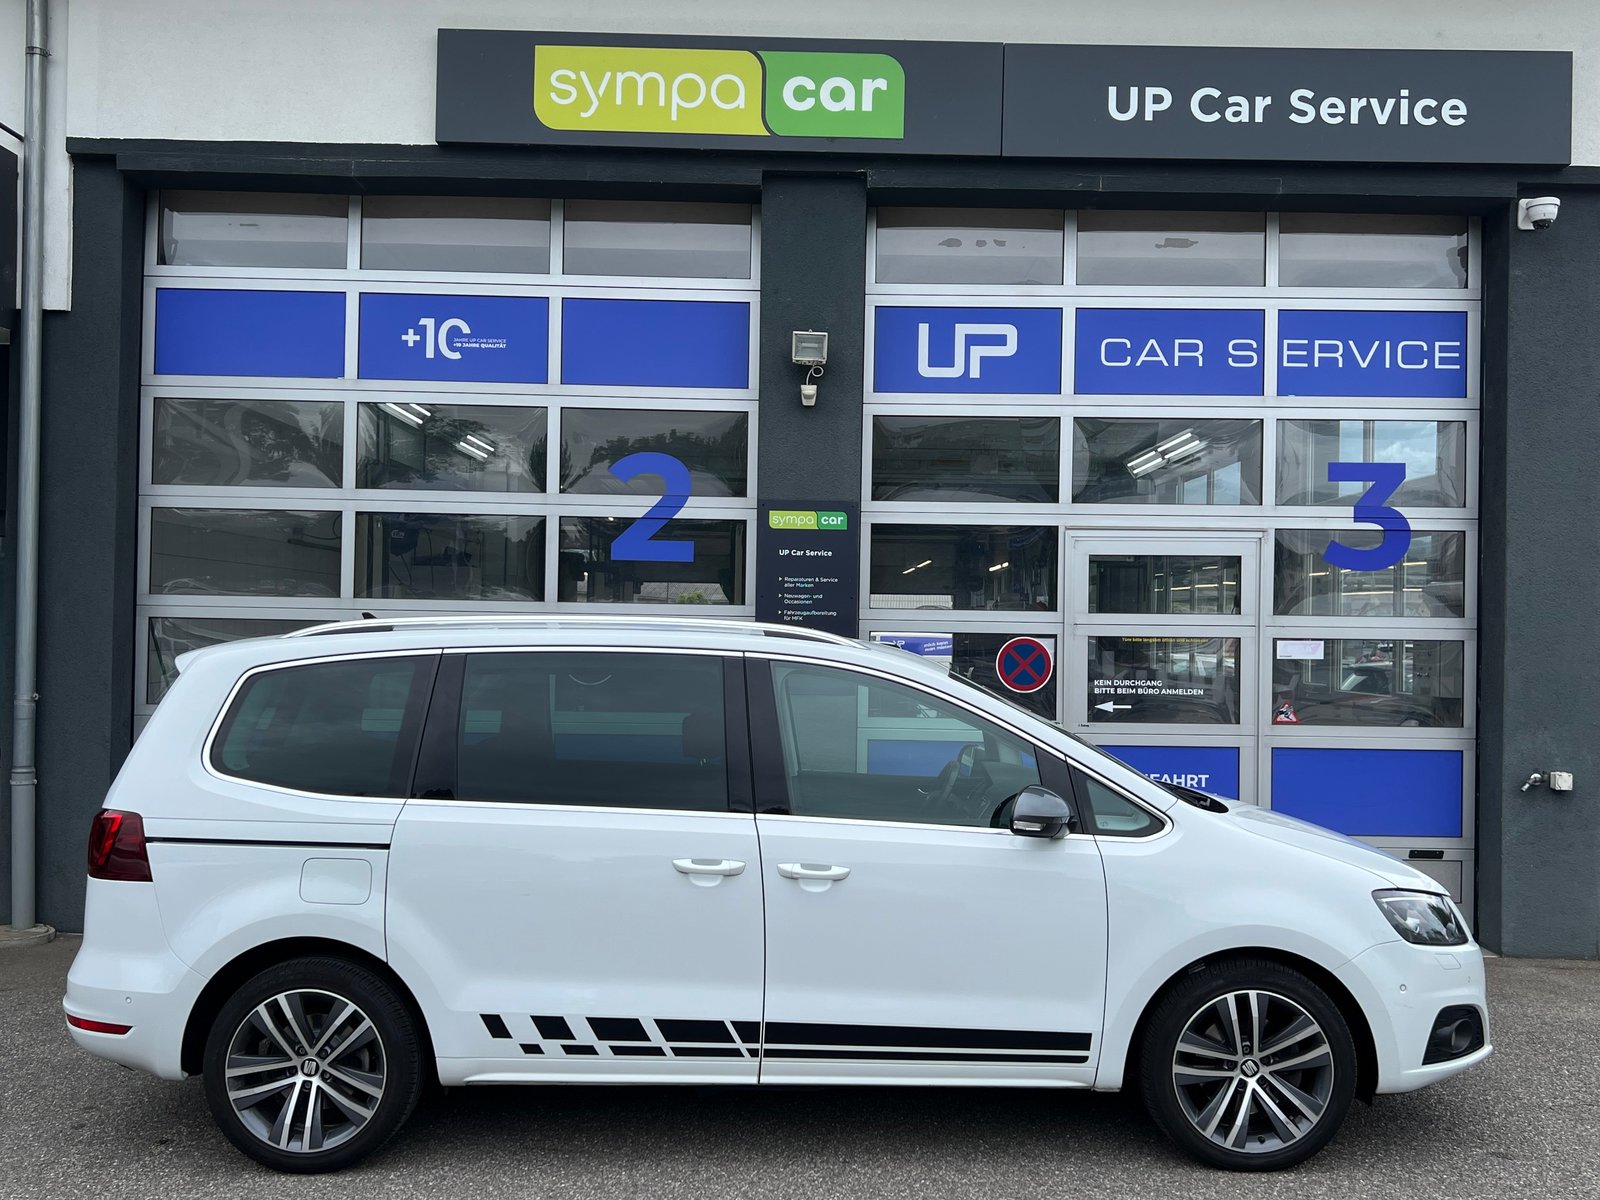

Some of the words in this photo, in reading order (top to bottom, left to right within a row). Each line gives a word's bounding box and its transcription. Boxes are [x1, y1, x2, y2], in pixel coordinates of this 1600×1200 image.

[550, 69, 746, 121] sympa
[782, 75, 887, 112] car
[1107, 86, 1173, 121] UP
[1190, 87, 1272, 123] Car
[1288, 88, 1468, 126] Service
[918, 323, 1018, 378] UP
[1100, 338, 1203, 368] CAR
[1228, 338, 1462, 370] SERVICE
[608, 452, 695, 562] 2
[772, 515, 815, 527] sympa
[821, 516, 844, 525] car
[1323, 462, 1411, 571] 3
[805, 549, 833, 557] Service
[783, 609, 837, 617] Fahrzeugaufbereitung
[1114, 679, 1163, 687] DURCHGANG
[1137, 687, 1160, 695] BÜRO
[1145, 773, 1209, 788] FAHRT
